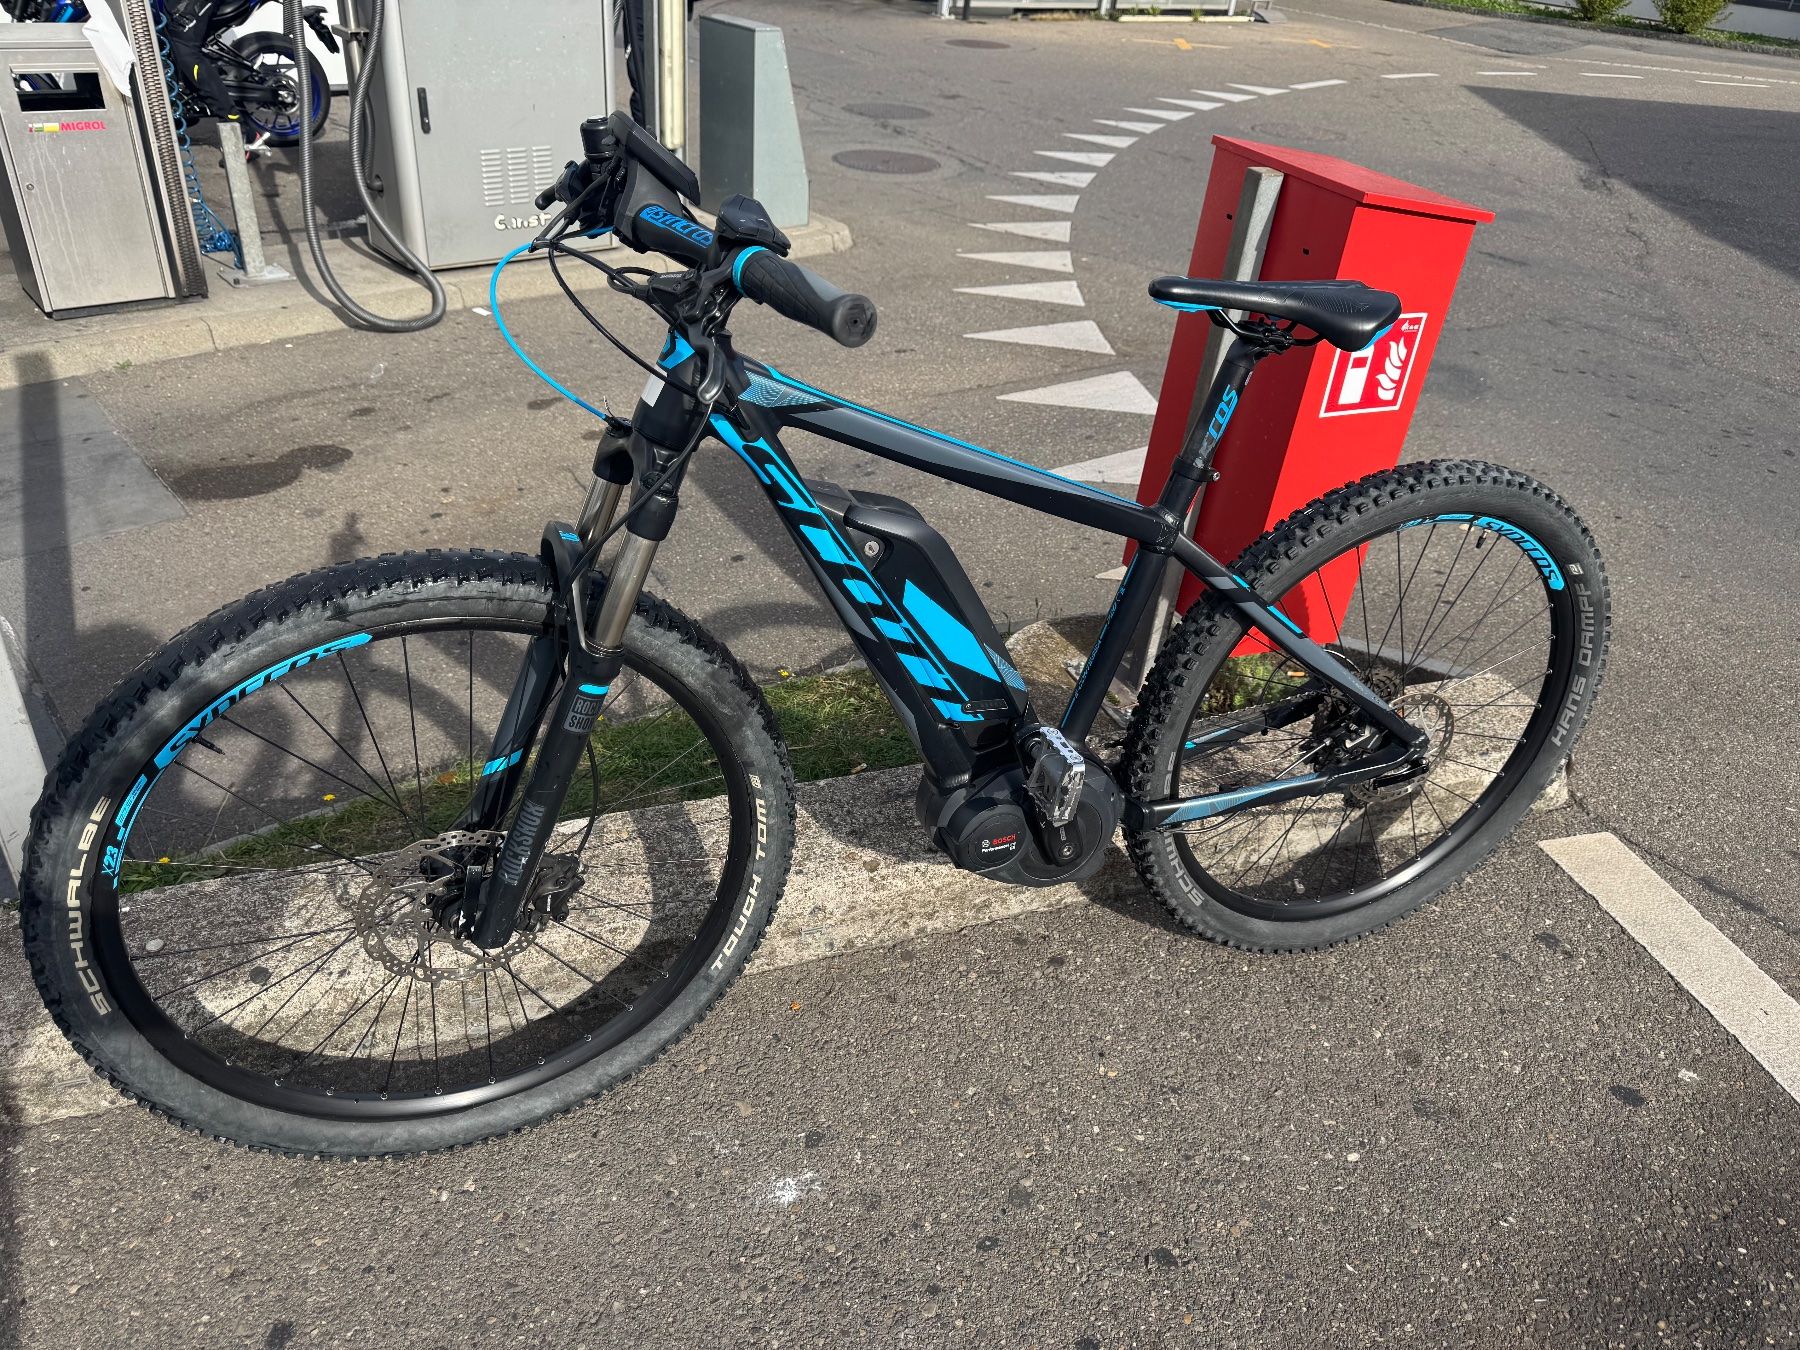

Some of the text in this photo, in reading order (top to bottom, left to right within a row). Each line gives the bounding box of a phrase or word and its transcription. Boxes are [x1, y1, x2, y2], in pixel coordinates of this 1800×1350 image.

[61, 121, 106, 131] MIGROL
[742, 442, 986, 722] SCOTT
[1551, 674, 1587, 747] HANS
[1574, 583, 1595, 667] DAMPF
[101, 845, 119, 876] X23
[498, 799, 545, 886] ROCKSHOX
[710, 873, 761, 970] TOUGH
[755, 798, 767, 860] TOM
[992, 833, 1016, 846] BOSCH
[67, 796, 112, 1015] SCHWALBE
